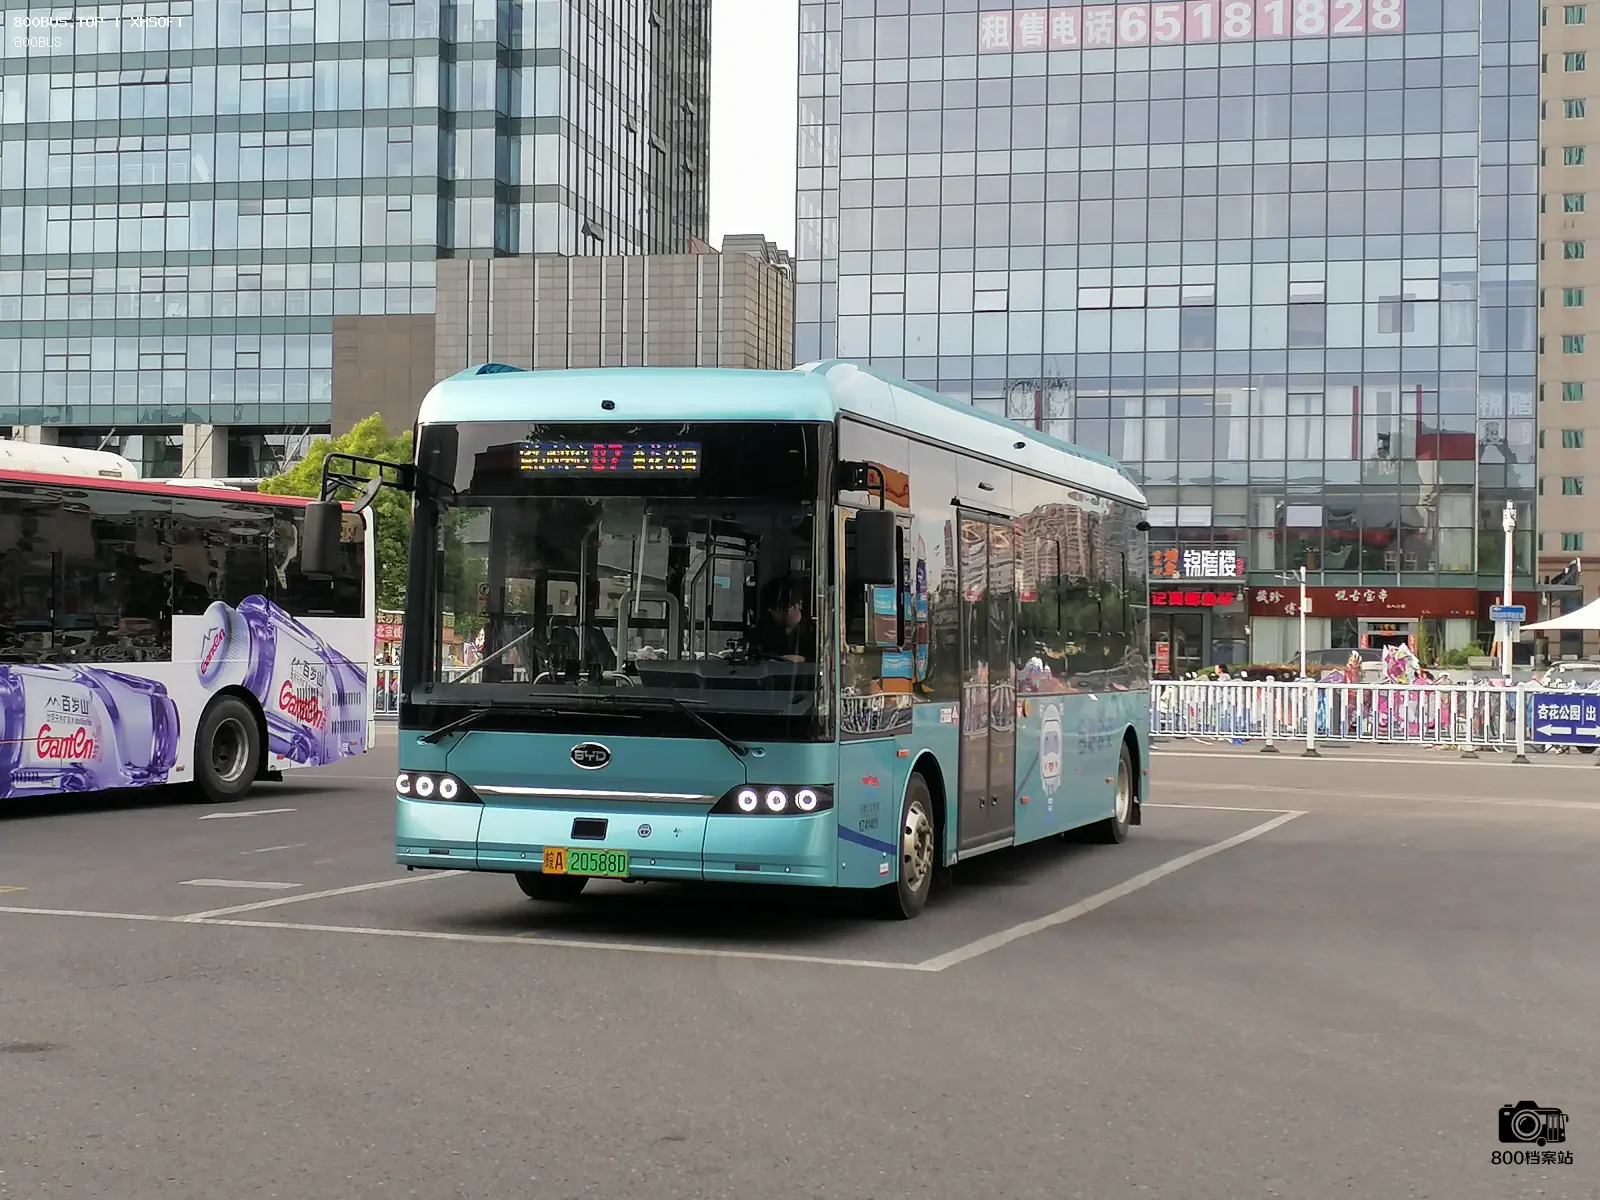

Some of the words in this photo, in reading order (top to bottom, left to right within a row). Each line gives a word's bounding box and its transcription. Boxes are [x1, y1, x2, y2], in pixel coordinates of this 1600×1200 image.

[61, 694, 90, 715] 百岁山
[1538, 703, 1581, 722] 杏花公园
[573, 749, 608, 762] BYD
